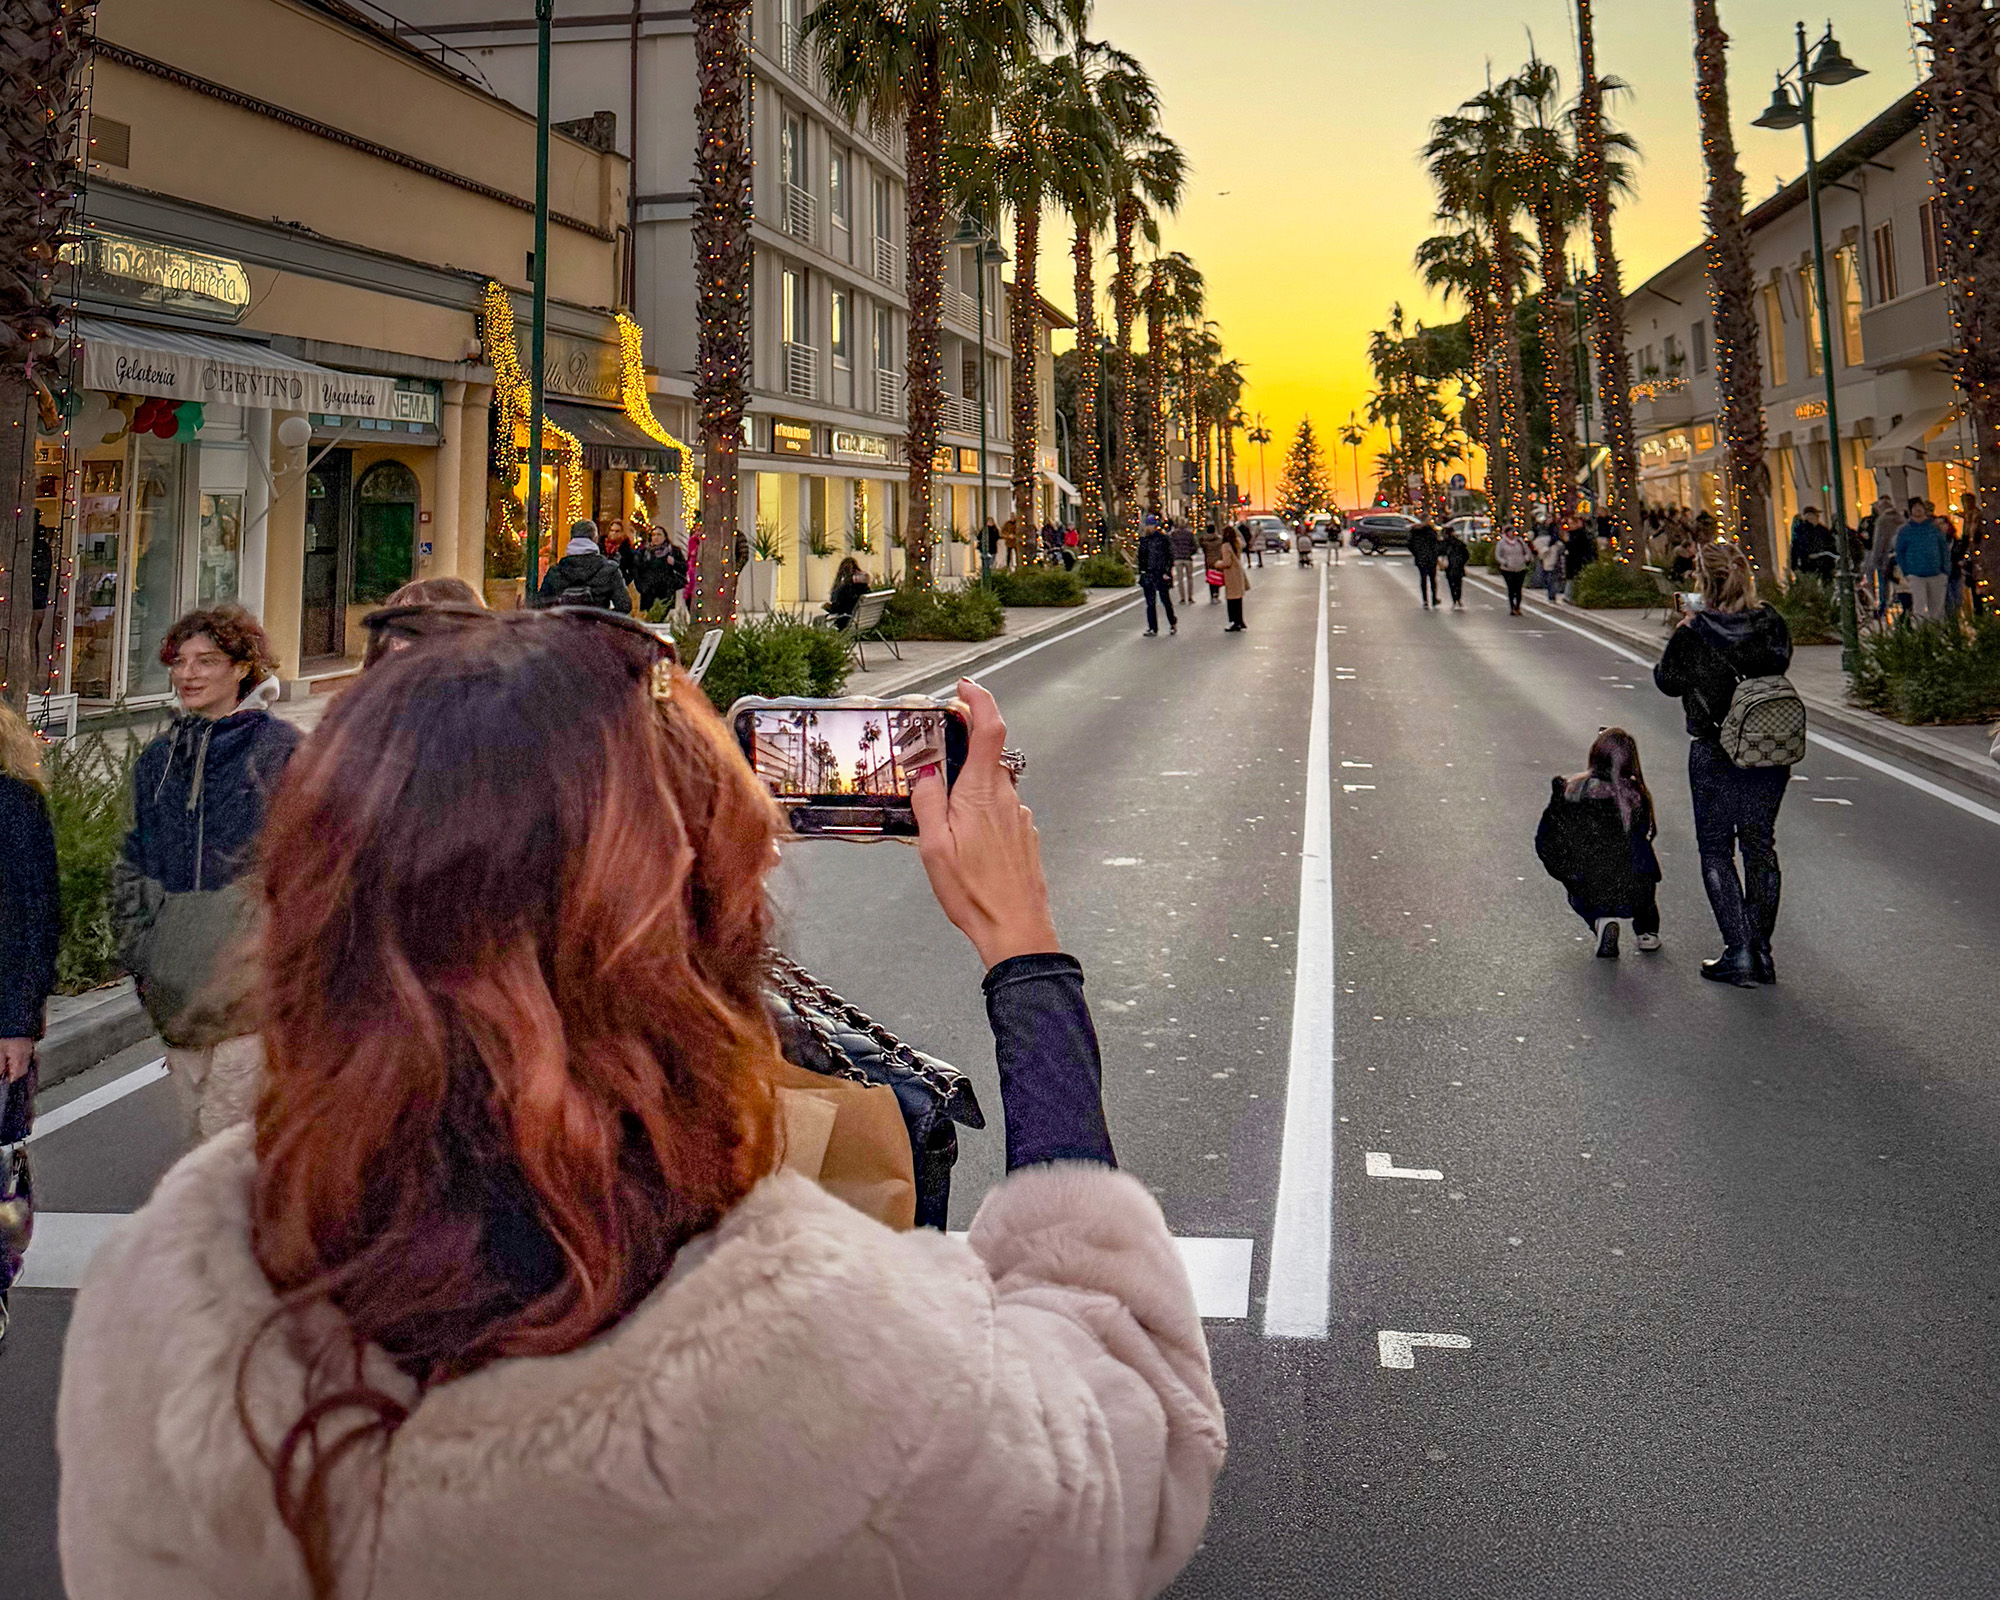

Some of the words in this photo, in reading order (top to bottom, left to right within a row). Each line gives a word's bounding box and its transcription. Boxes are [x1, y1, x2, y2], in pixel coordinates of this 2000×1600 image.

[170, 262, 236, 300] gelateria
[116, 356, 176, 386] Gelateria
[202, 366, 303, 400] CERVINO
[393, 392, 429, 420] NEMA
